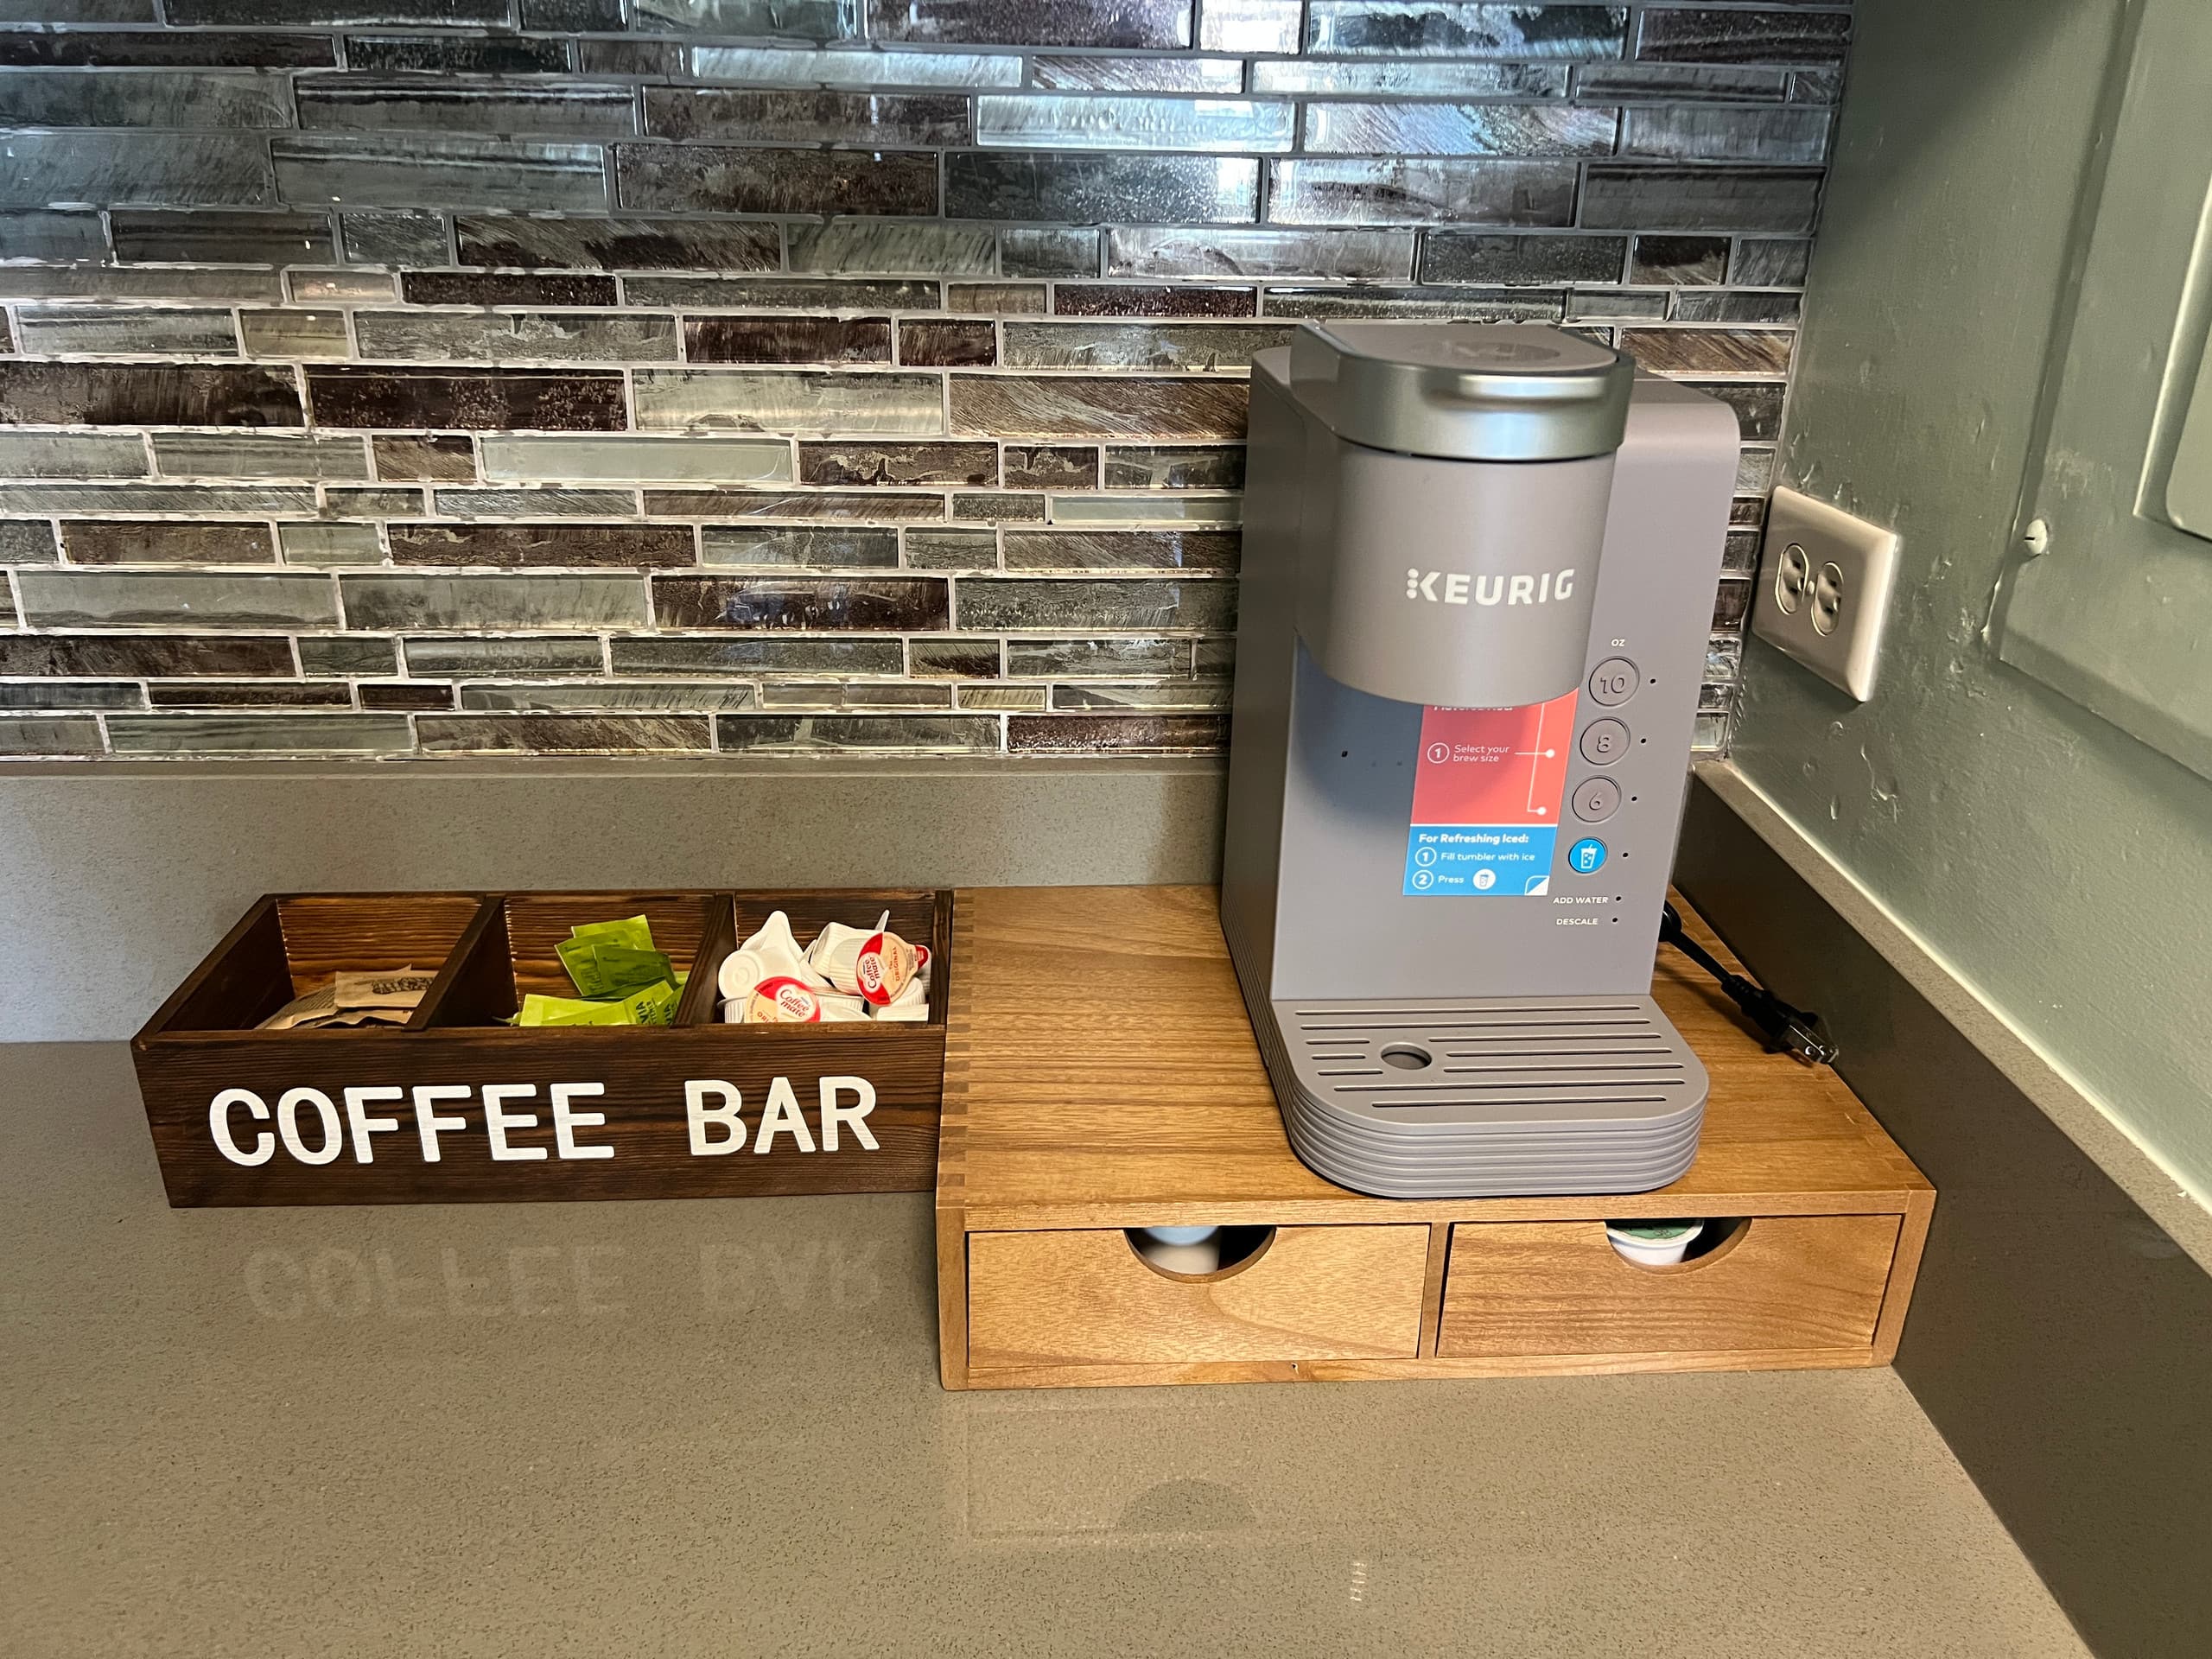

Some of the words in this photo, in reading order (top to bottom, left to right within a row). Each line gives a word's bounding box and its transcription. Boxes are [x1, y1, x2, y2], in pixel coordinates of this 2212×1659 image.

[1406, 568, 1575, 606] KEURIG
[1600, 676, 1625, 695] 10
[1454, 744, 1484, 753] Select
[1486, 746, 1511, 756] your
[1597, 734, 1611, 753] 8
[1452, 753, 1478, 762] brew
[1480, 753, 1500, 762] size
[1588, 792, 1602, 811] 6
[1418, 833, 1438, 843] For
[1440, 833, 1501, 846] Refreshing
[1502, 833, 1529, 843] Iced:
[1440, 852, 1455, 861] Fill
[1457, 852, 1496, 861] tumbler
[1497, 852, 1519, 861] with
[1521, 853, 1535, 861] ice
[1437, 874, 1465, 884] Press
[865, 959, 877, 988] Coffee
[779, 988, 810, 1013] Coffee
[780, 1000, 806, 1018] mate
[207, 1082, 616, 1166] COFFEE
[683, 1076, 880, 1156] BAR
